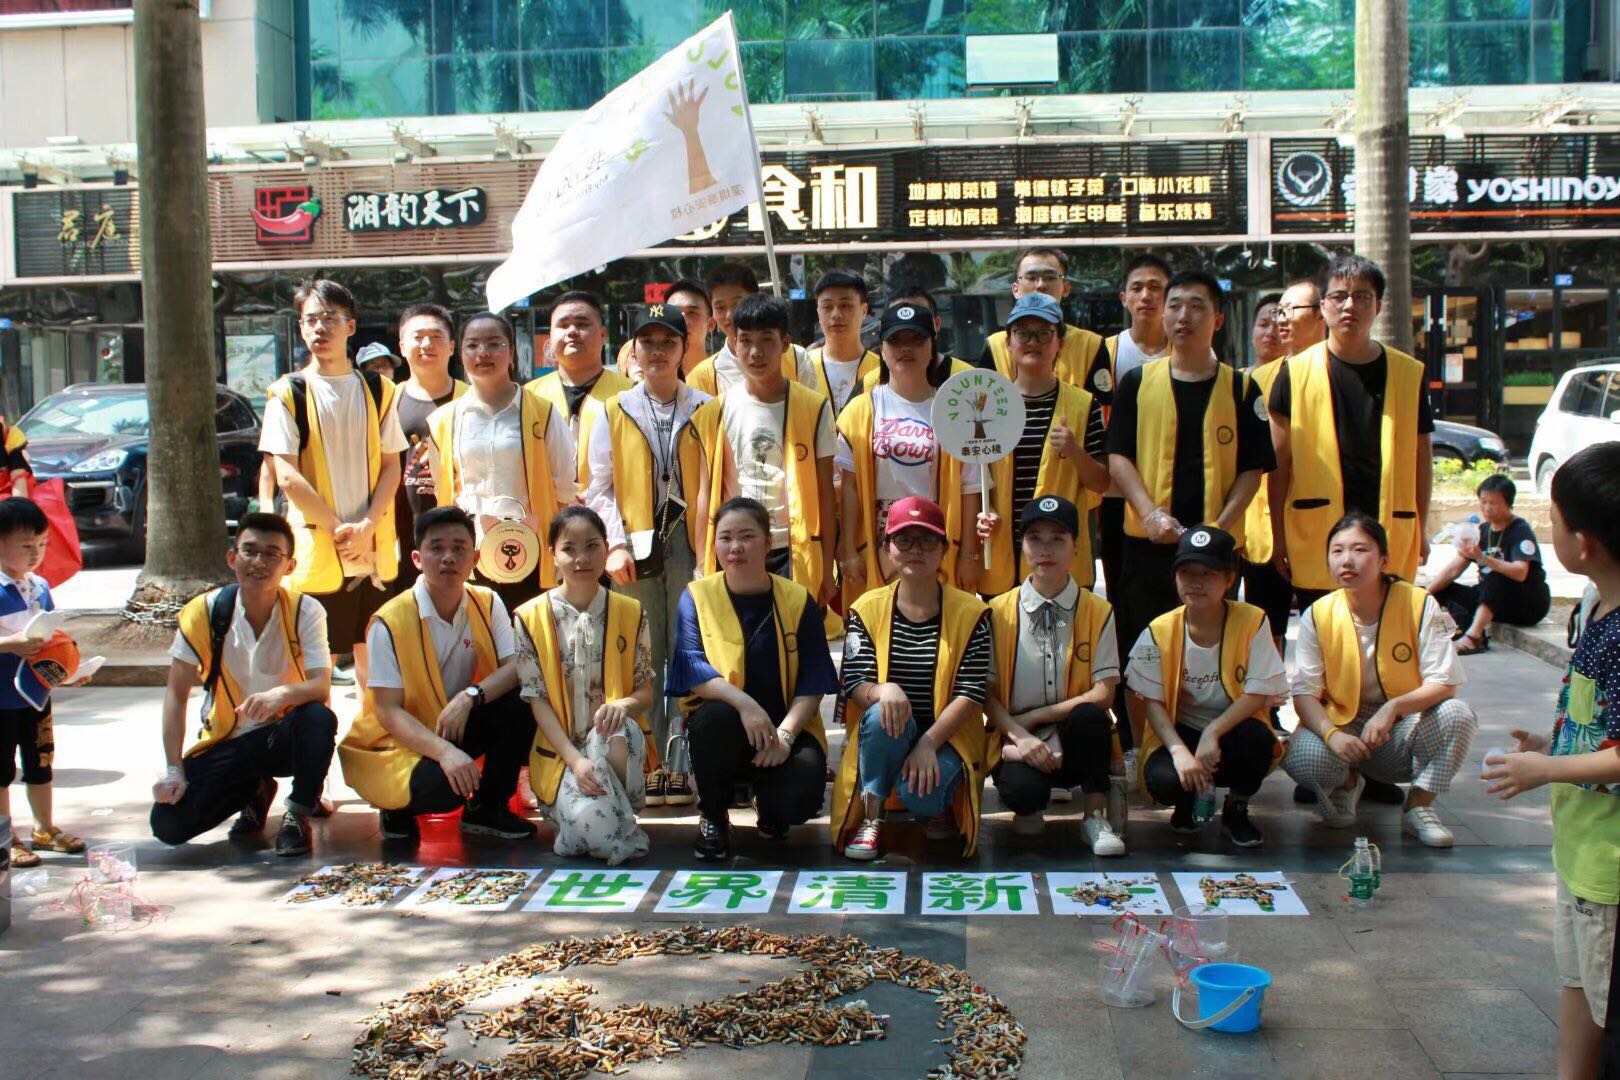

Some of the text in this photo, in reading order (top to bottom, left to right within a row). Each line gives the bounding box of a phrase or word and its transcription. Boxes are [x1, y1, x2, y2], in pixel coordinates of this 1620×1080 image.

[347, 188, 481, 231] 湘韵天下
[908, 208, 998, 227] 定制私房菜
[947, 374, 1008, 421] VOLUNTEER
